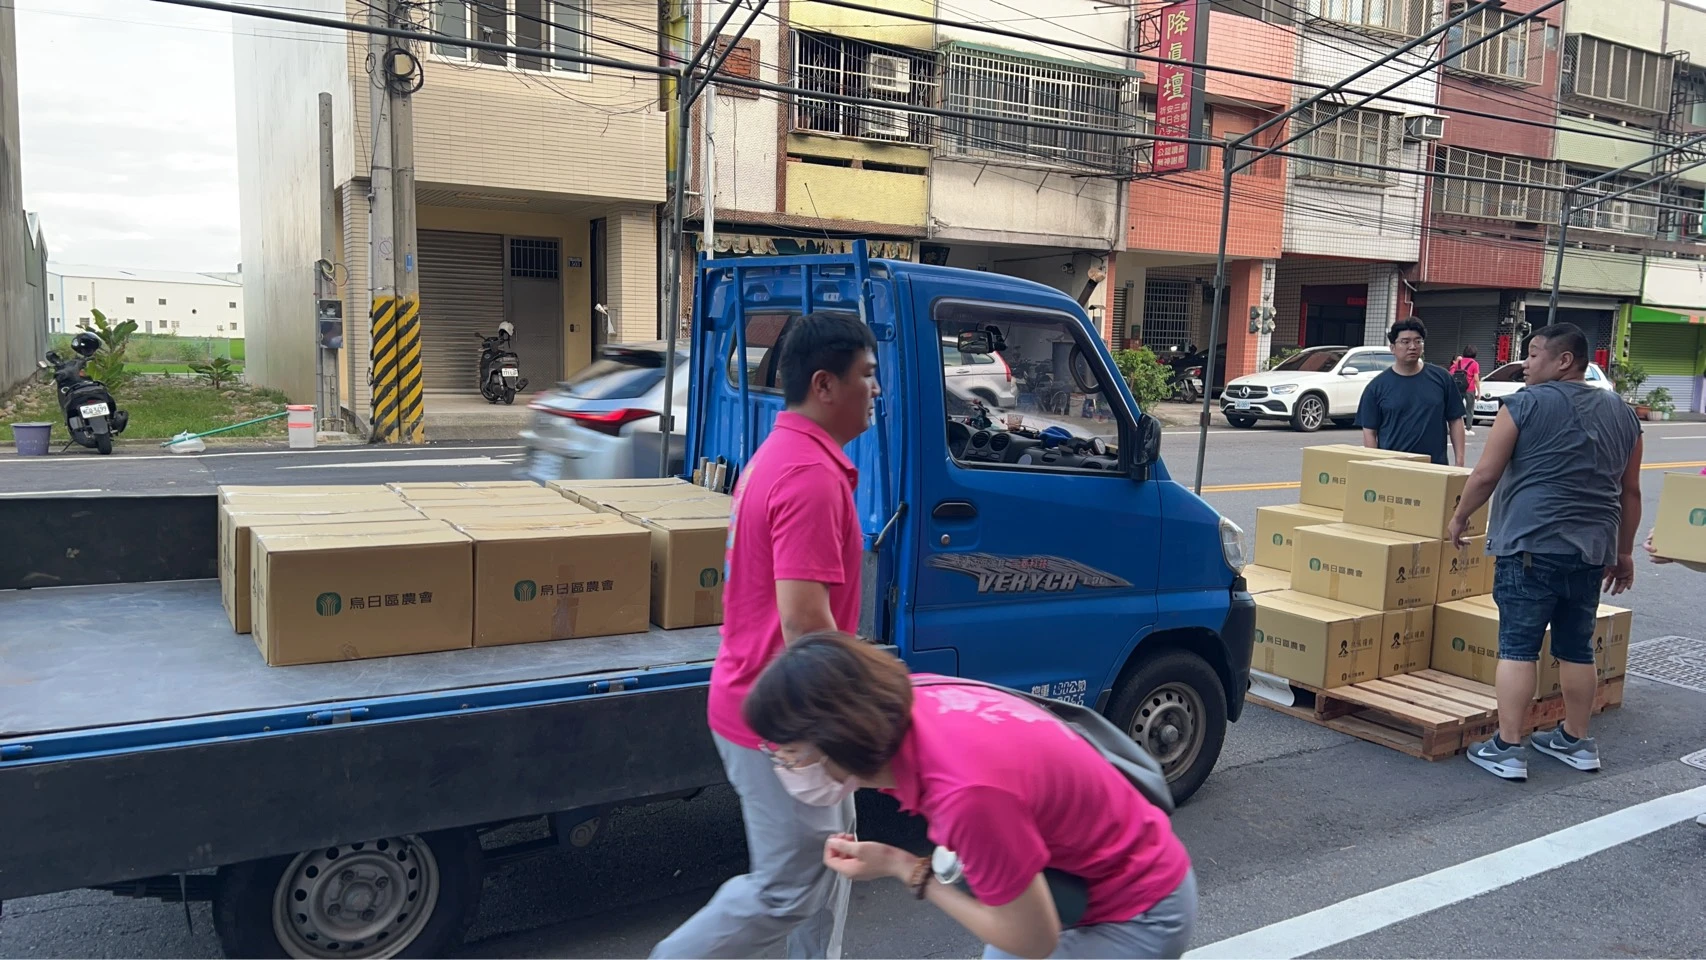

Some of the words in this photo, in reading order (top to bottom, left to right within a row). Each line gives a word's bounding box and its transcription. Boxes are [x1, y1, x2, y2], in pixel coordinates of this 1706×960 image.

[540, 579, 614, 597] 烏日區農會
[978, 572, 1079, 593] VERYCA
[349, 591, 433, 610] 烏日區農會
